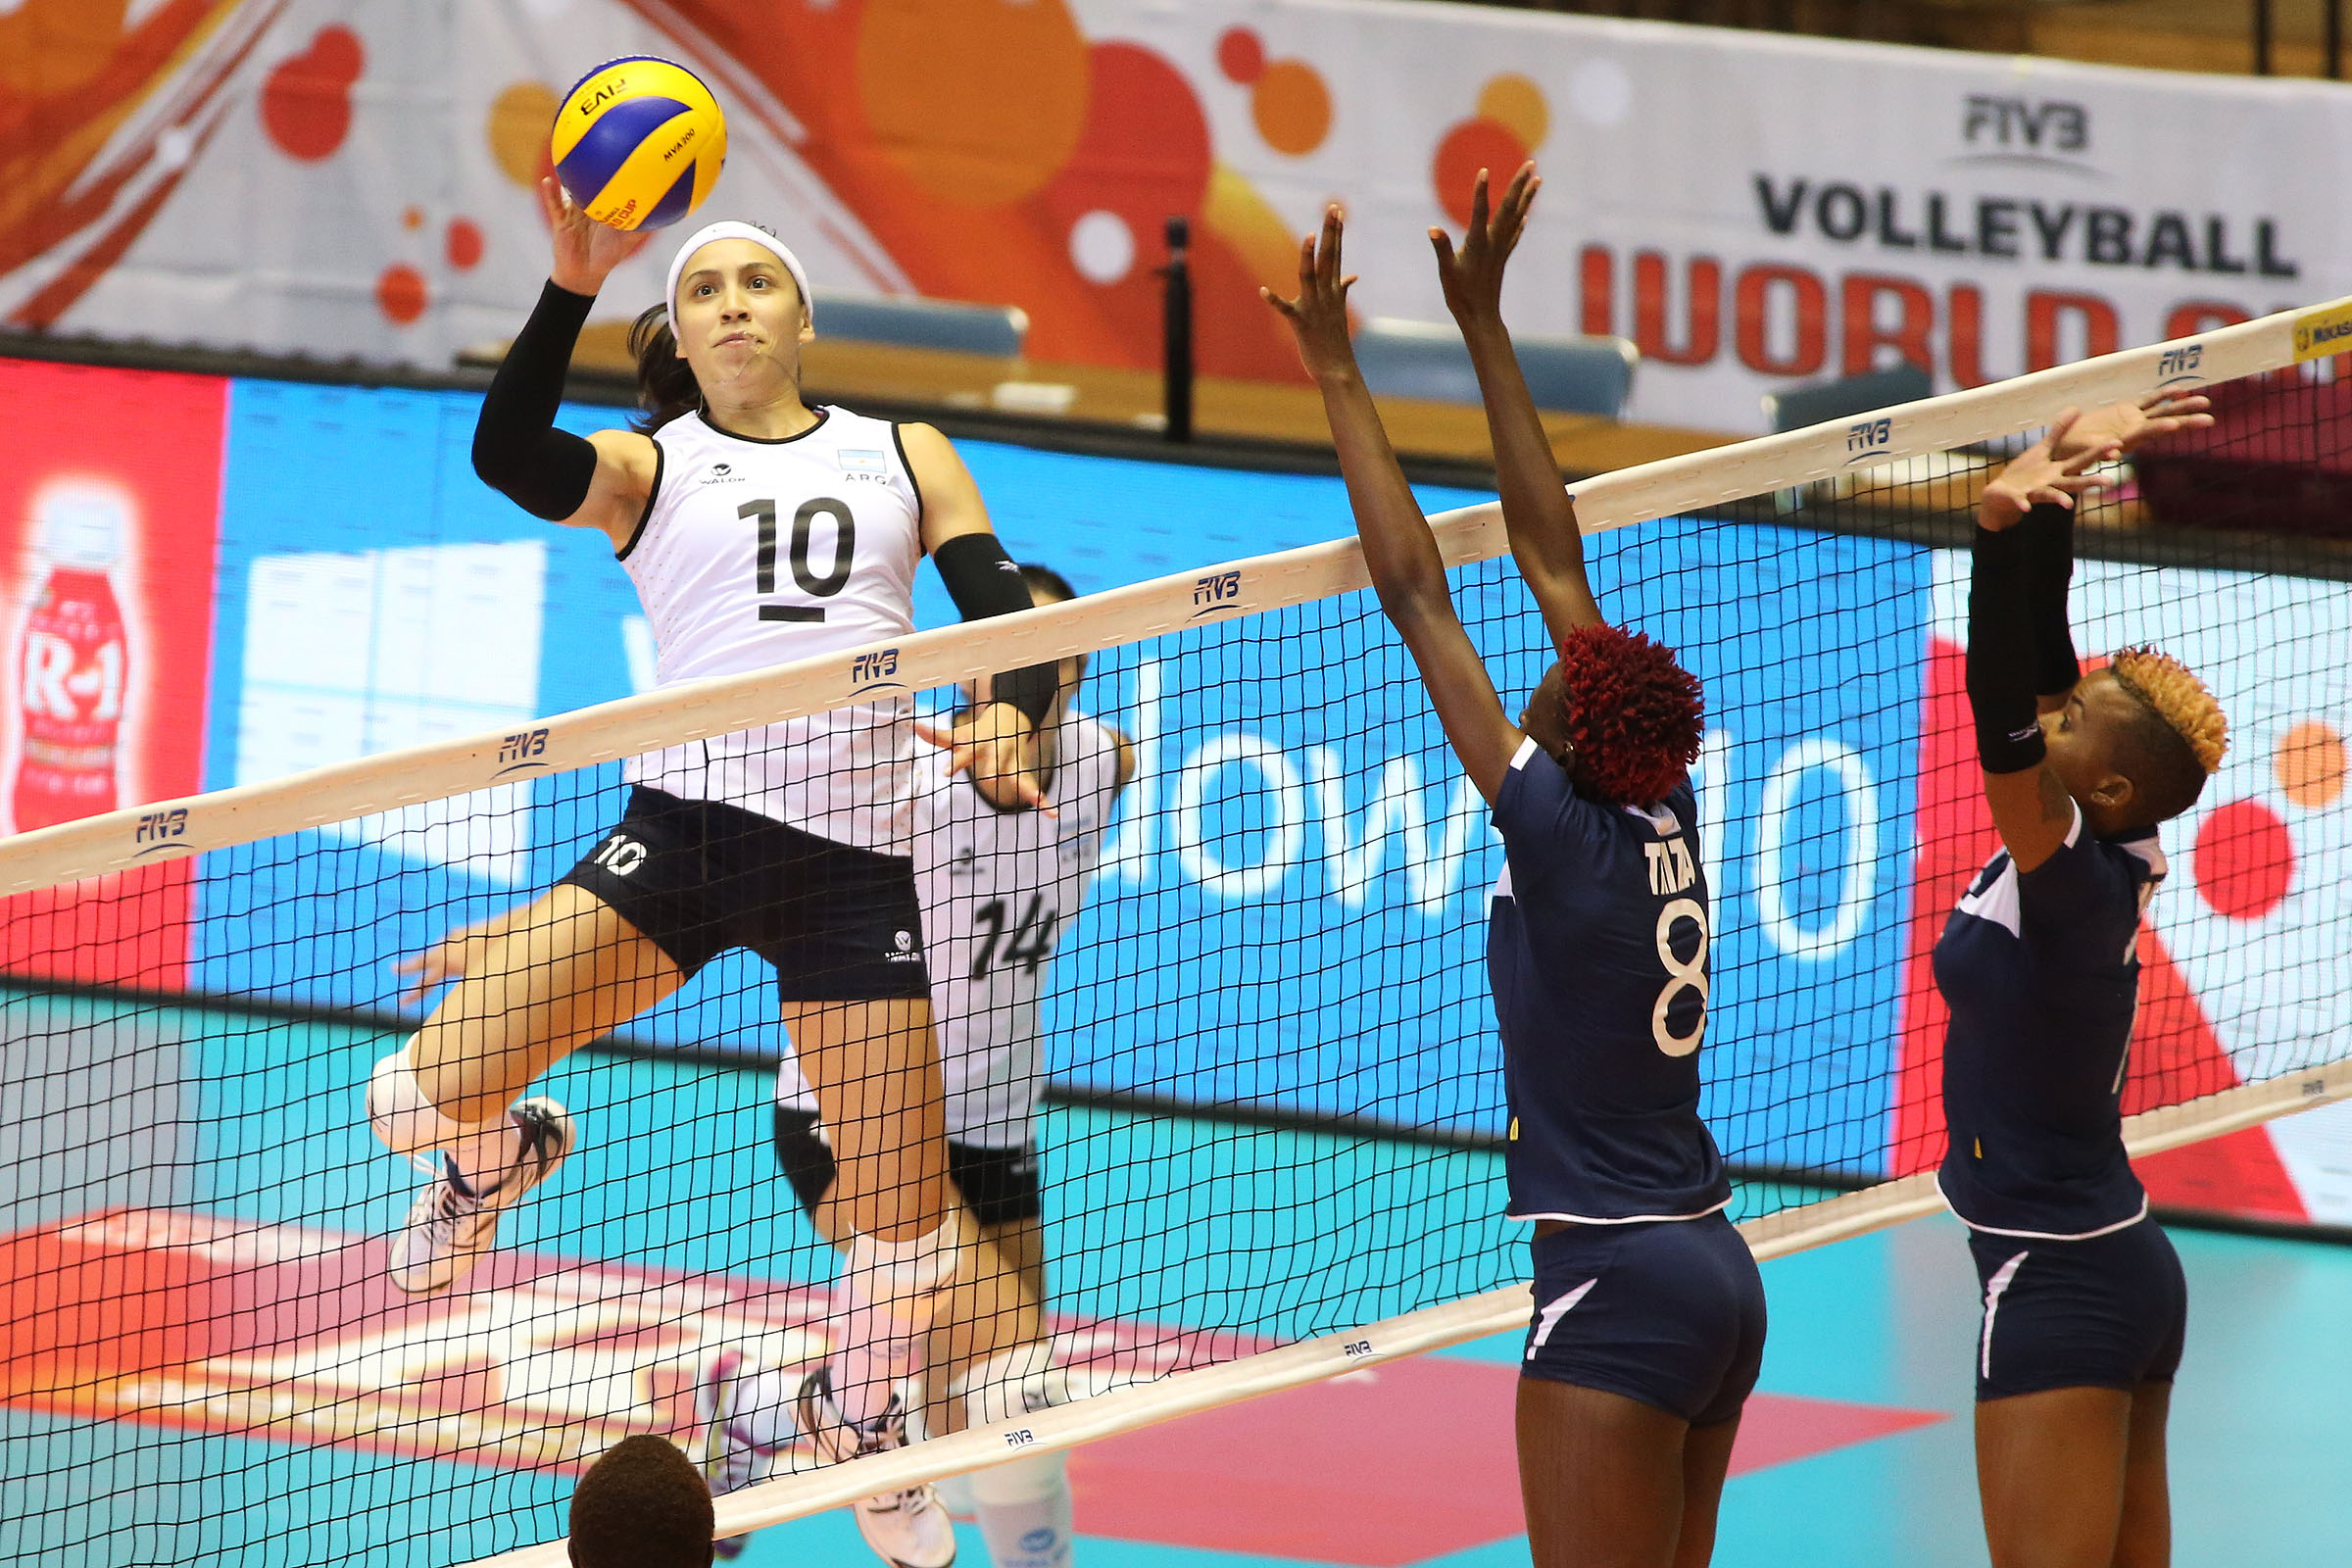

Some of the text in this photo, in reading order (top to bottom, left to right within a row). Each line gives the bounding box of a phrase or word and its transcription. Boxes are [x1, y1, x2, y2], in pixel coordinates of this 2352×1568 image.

[1962, 95, 2091, 153] FIVB
[1754, 172, 2299, 279] VOLLEYBALL
[1581, 245, 2119, 390] WORLD
[2159, 344, 2203, 376] FIVB
[1847, 417, 1892, 452] FIVB
[845, 472, 887, 485] ARG
[737, 497, 855, 597] 10
[1194, 570, 1241, 605] FIVB
[24, 630, 122, 723] R-1
[853, 648, 899, 683] FIVB
[499, 728, 549, 763] FIVB
[137, 808, 188, 843] FIVB
[594, 834, 648, 876] 10
[973, 894, 1056, 981] 14
[1652, 898, 1709, 1057] 8
[1345, 1340, 1373, 1356] FIVB
[1004, 1429, 1034, 1446] FIVB
